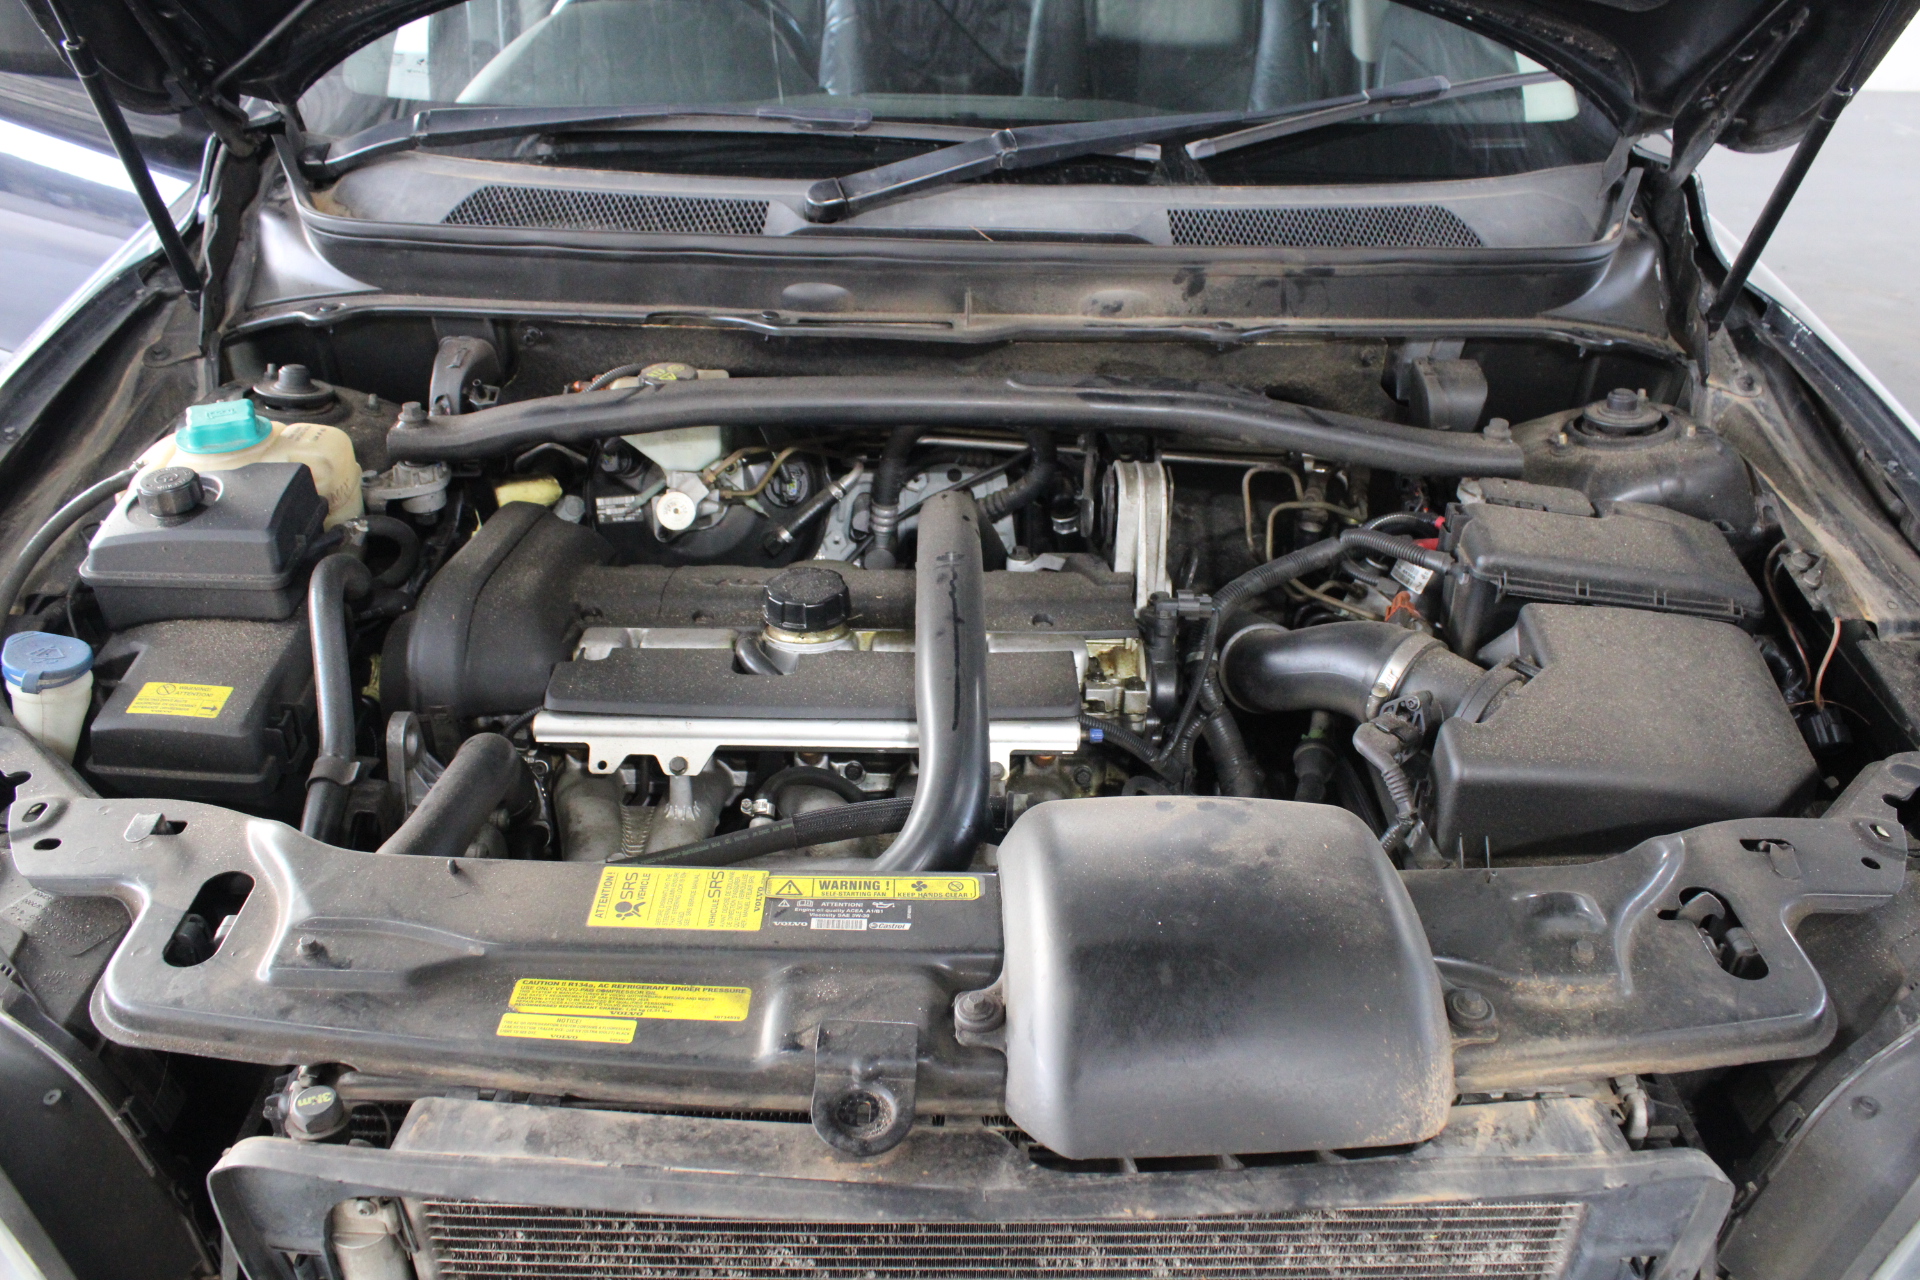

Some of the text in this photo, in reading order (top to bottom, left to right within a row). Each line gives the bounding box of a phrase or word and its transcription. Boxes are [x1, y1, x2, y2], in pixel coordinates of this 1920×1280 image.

[594, 872, 614, 917] ATTENTION!
[620, 872, 638, 898] SRS
[637, 873, 650, 899] VEHICLE
[819, 881, 890, 890] WARNING !
[707, 871, 724, 926] VEHICULE SRS
[754, 886, 762, 911] VOLVO
